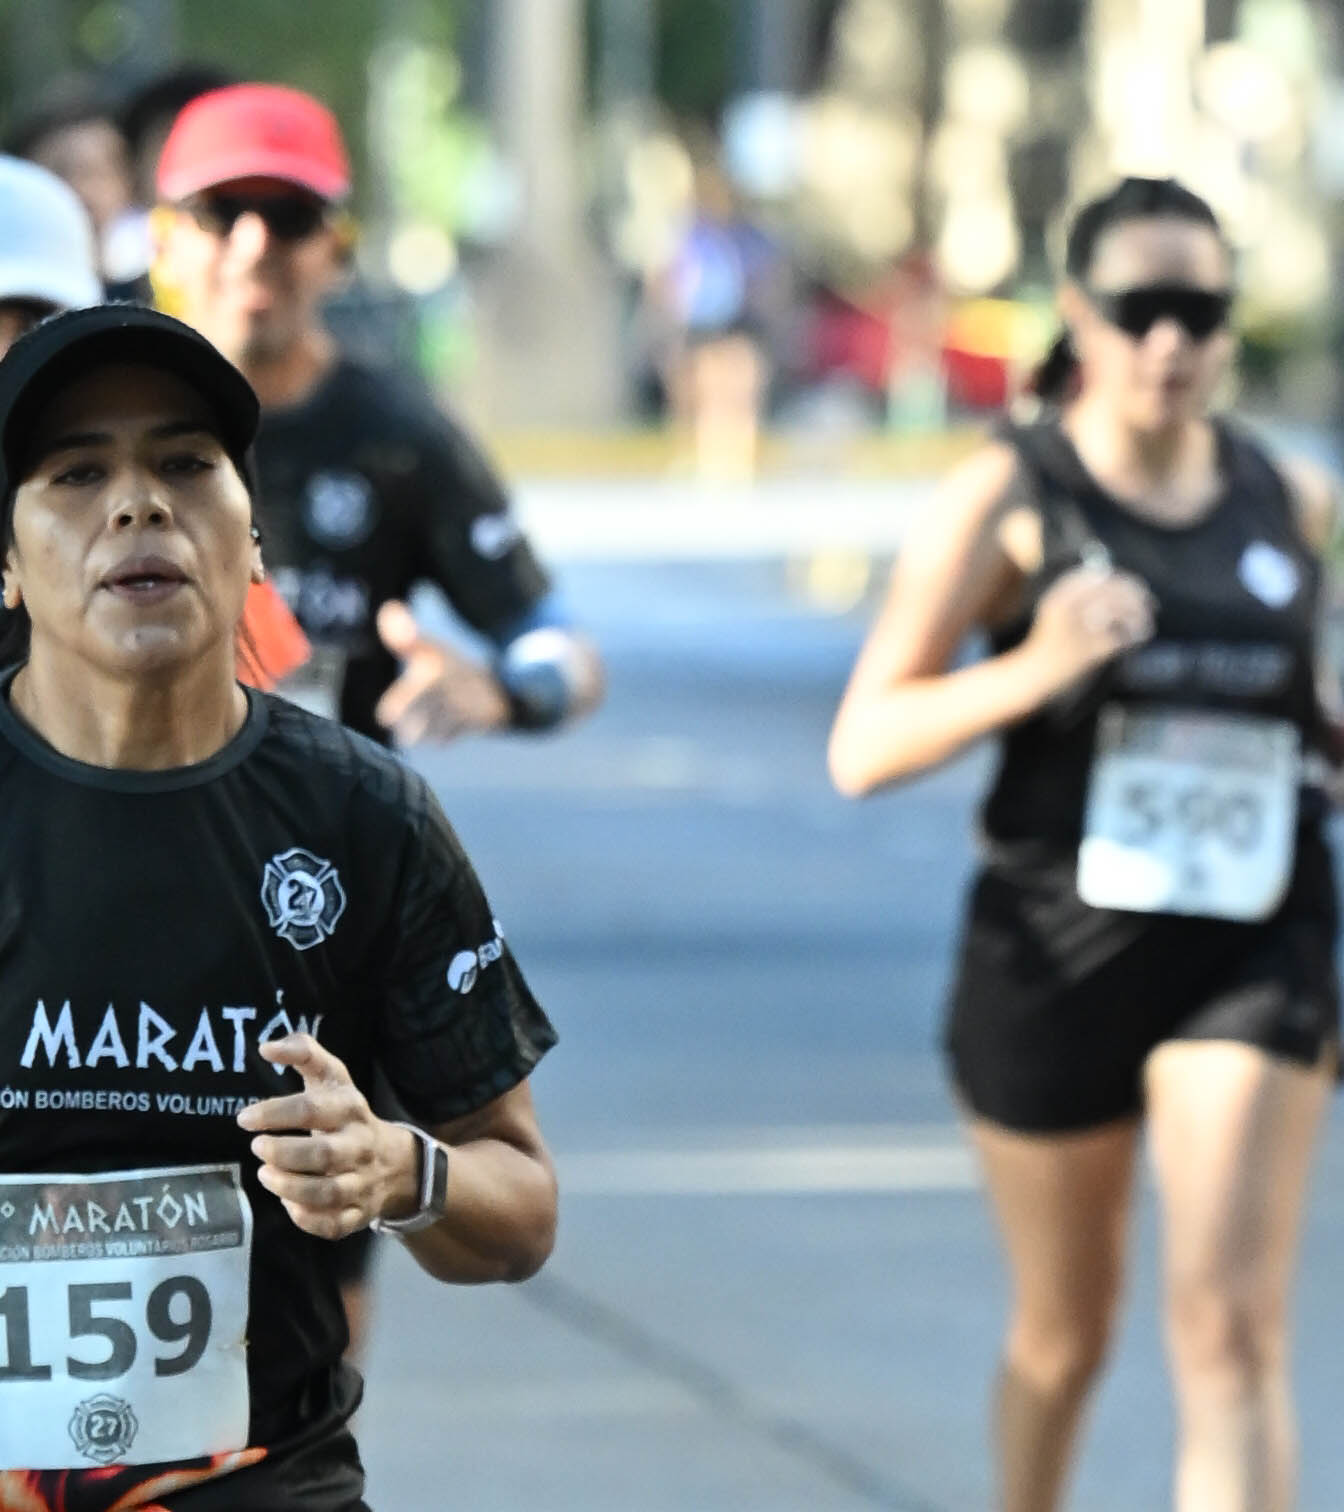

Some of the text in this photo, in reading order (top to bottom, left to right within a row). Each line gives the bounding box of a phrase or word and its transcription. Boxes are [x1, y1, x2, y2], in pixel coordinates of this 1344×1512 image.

[35, 1090, 150, 1112] BOMBEROS
[29, 1184, 209, 1236] MARATÓN
[0, 1275, 212, 1382] 159
